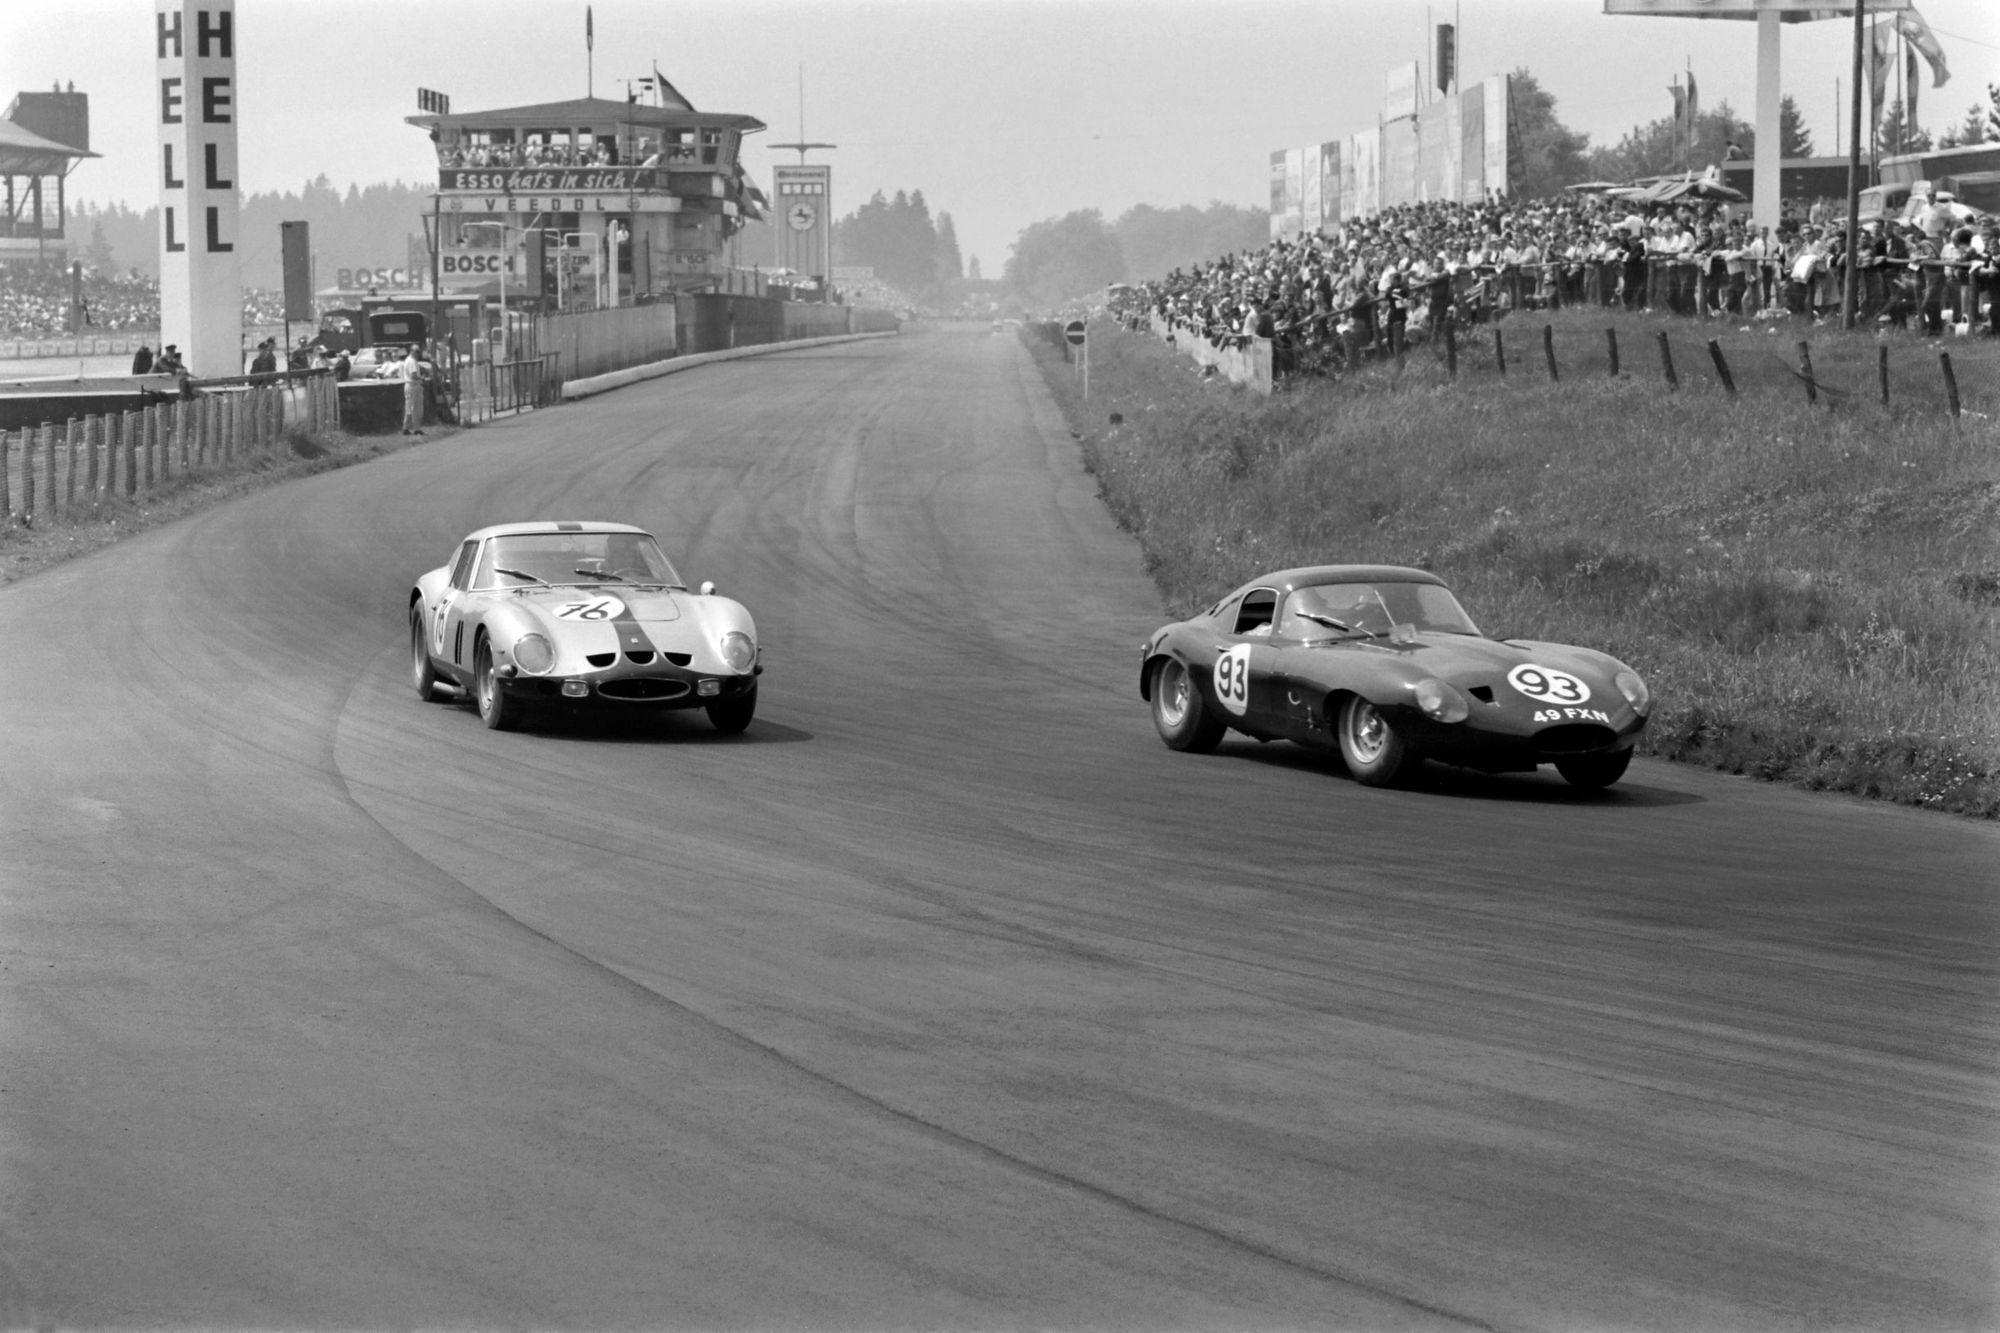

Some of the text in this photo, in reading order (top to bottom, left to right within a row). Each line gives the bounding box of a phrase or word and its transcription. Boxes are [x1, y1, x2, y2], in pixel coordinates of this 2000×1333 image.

[157, 11, 185, 252] HELL
[198, 11, 234, 252] HELL
[456, 173, 504, 188] ESSO
[508, 171, 554, 188] hat's
[560, 171, 579, 188] in
[485, 199, 605, 211] VEEDOL
[443, 255, 514, 273] BOSCH
[337, 268, 423, 290] BOSCH
[559, 601, 611, 620] 76
[1218, 653, 1246, 703] 93
[1517, 668, 1583, 701] 93
[1533, 708, 1609, 724] 49 FXN
